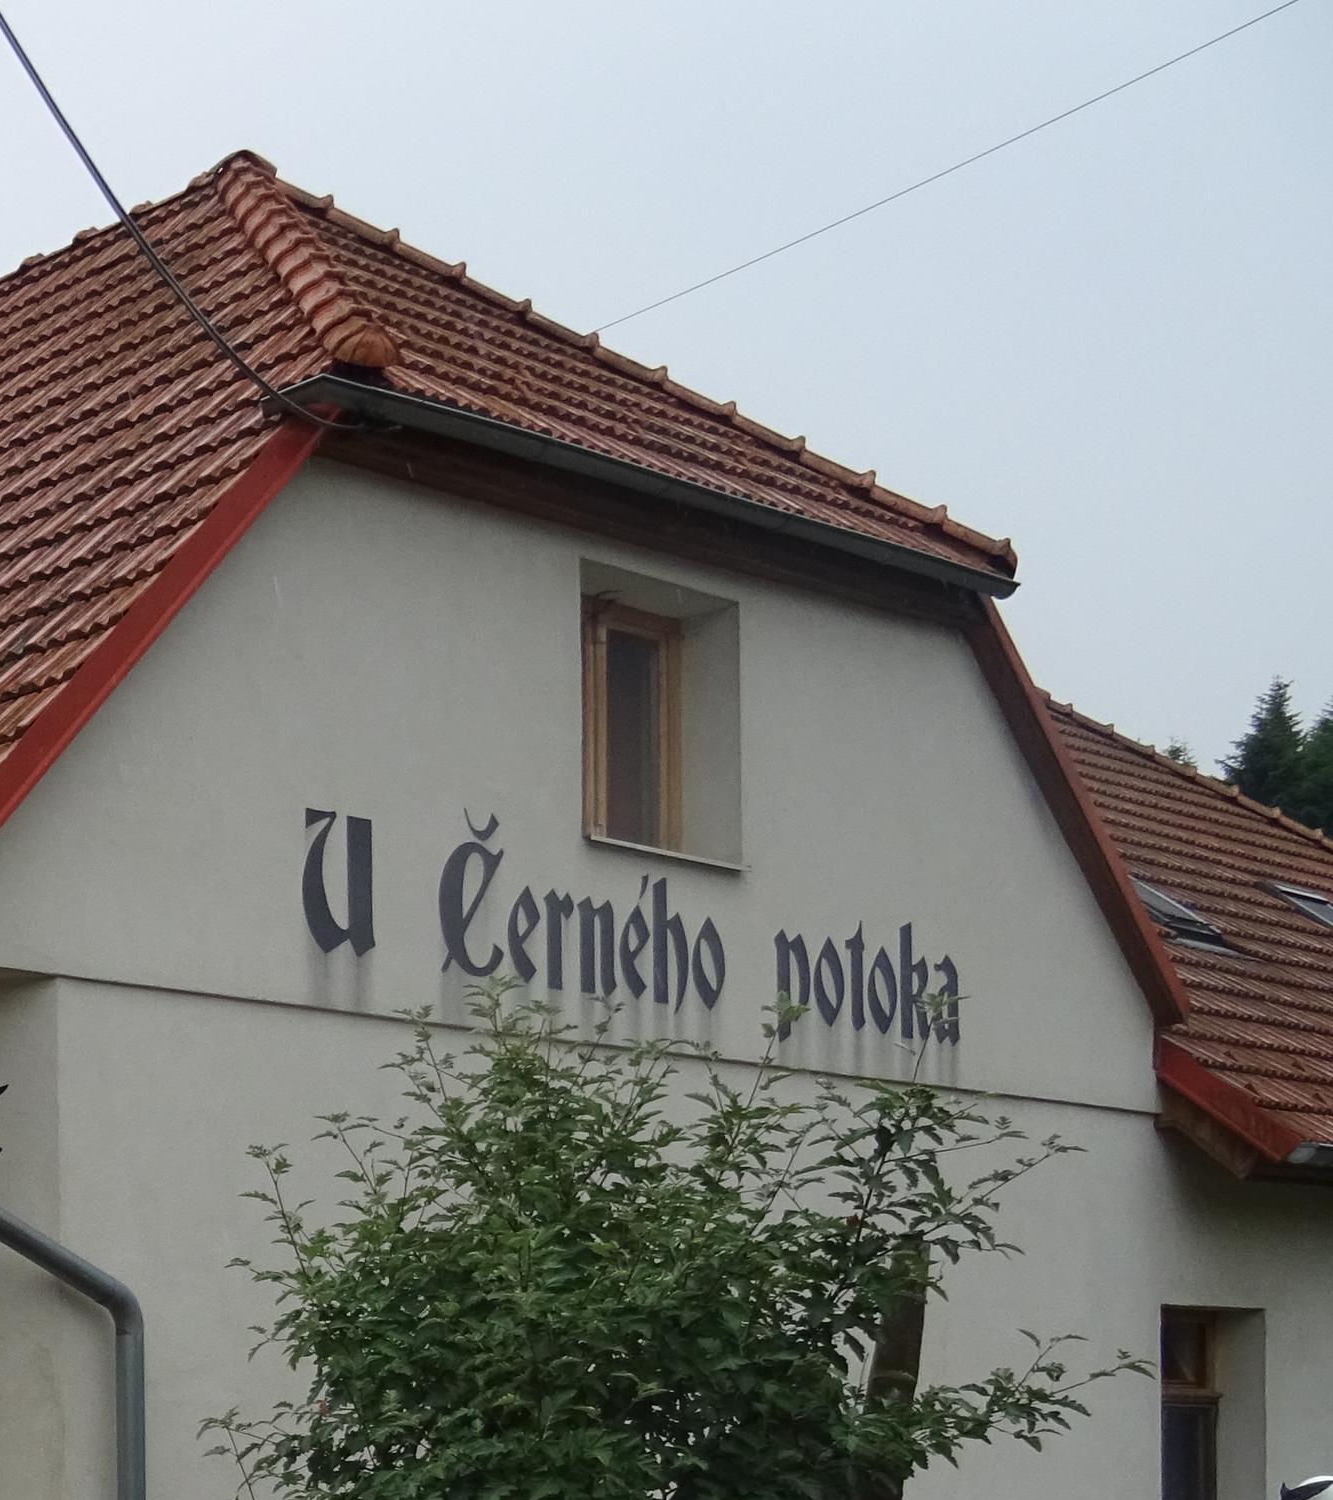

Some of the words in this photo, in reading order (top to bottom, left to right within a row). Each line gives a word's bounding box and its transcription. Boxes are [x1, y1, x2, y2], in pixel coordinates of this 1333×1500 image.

[301, 807, 376, 958] U
[437, 807, 727, 1016] Černého
[773, 919, 961, 1047] potoka
